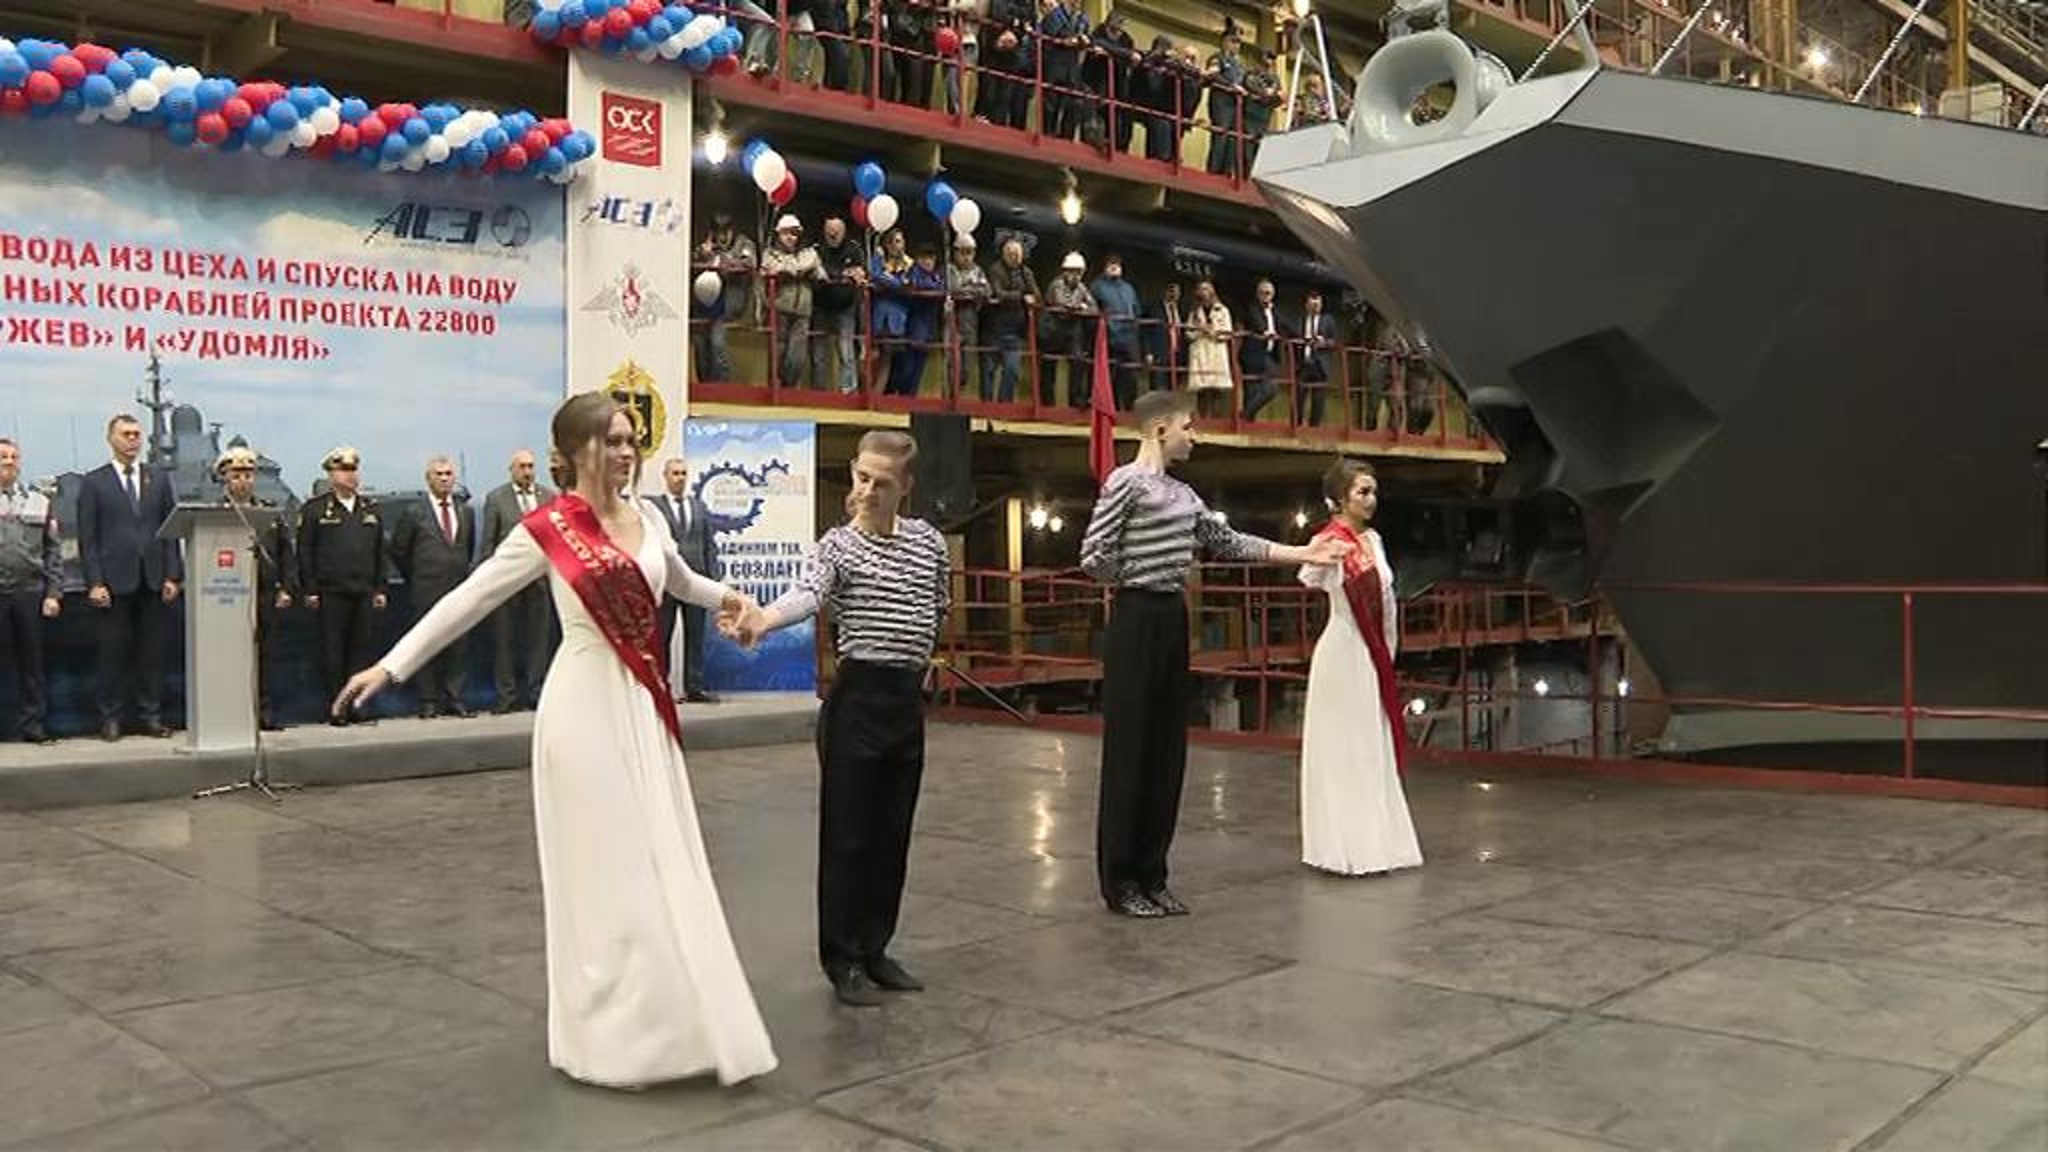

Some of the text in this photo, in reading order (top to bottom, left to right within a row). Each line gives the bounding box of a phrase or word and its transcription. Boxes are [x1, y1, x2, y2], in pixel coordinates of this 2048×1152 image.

[607, 105, 655, 135] ОСК
[110, 247, 153, 272] ИЗ
[163, 250, 248, 280] ЦЕХА
[257, 258, 276, 284] И
[284, 262, 399, 293] СПУСКА
[406, 271, 442, 297] НА
[449, 274, 518, 305] ВОДУ
[97, 283, 271, 321] КОРАБЛЕЙ
[280, 298, 411, 332] ПРОЕКТА
[418, 310, 495, 335] 22800
[0, 317, 331, 361] ЖЕВ» И «УДОМЛЯ»
